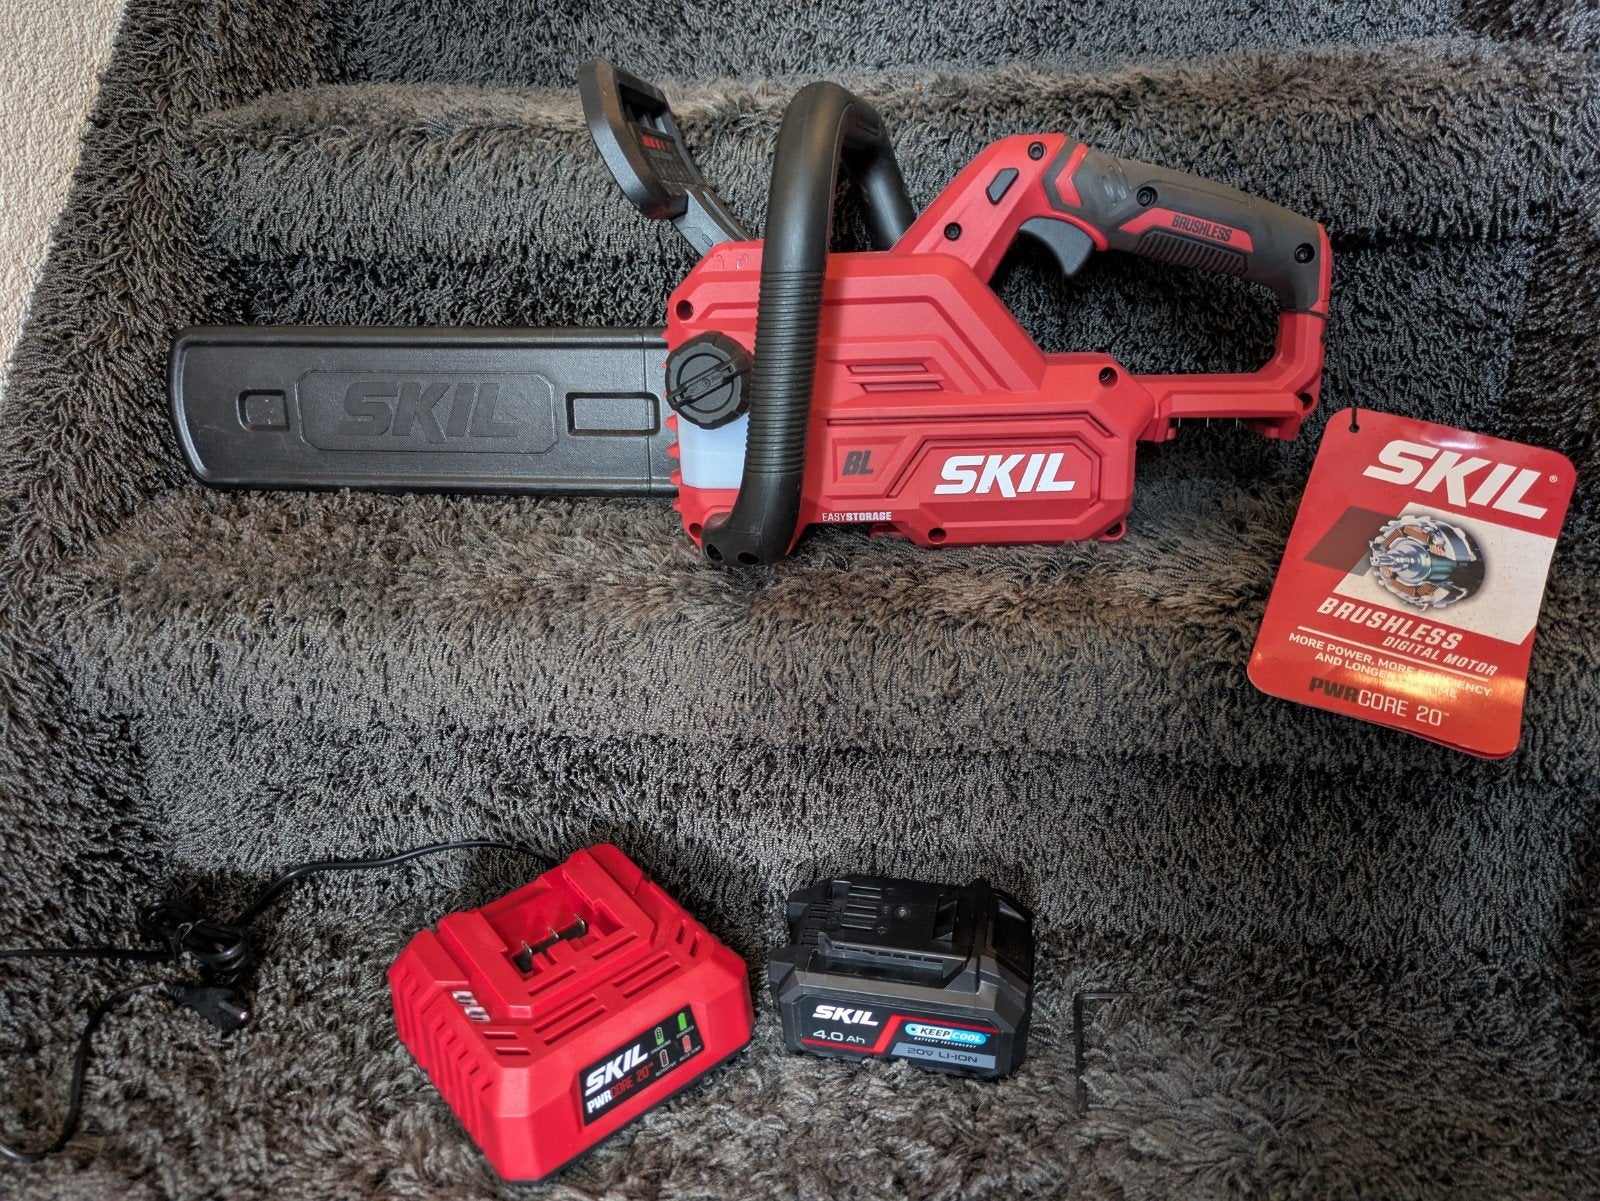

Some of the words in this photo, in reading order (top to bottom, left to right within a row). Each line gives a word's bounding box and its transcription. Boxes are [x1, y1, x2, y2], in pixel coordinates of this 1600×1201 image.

[1172, 214, 1232, 242] BRUSHLESS
[338, 380, 520, 445] SKIL
[842, 450, 875, 477] BL
[933, 452, 1076, 498] SKIL
[1362, 439, 1548, 520] SKIL
[1317, 596, 1464, 651] BRUSHLESS
[1288, 632, 1325, 651] MORE
[1326, 643, 1376, 667] POWER,
[1378, 657, 1415, 675] MORE
[1314, 652, 1343, 667] AND
[1382, 635, 1439, 661] DIGITAL
[1443, 653, 1499, 677] MOTOR
[812, 1004, 879, 1026] SKIL
[812, 1029, 844, 1042] 4.0
[846, 1035, 866, 1044] Ah
[585, 1043, 649, 1097] SKIL
[938, 1052, 978, 1064] LI-ION
